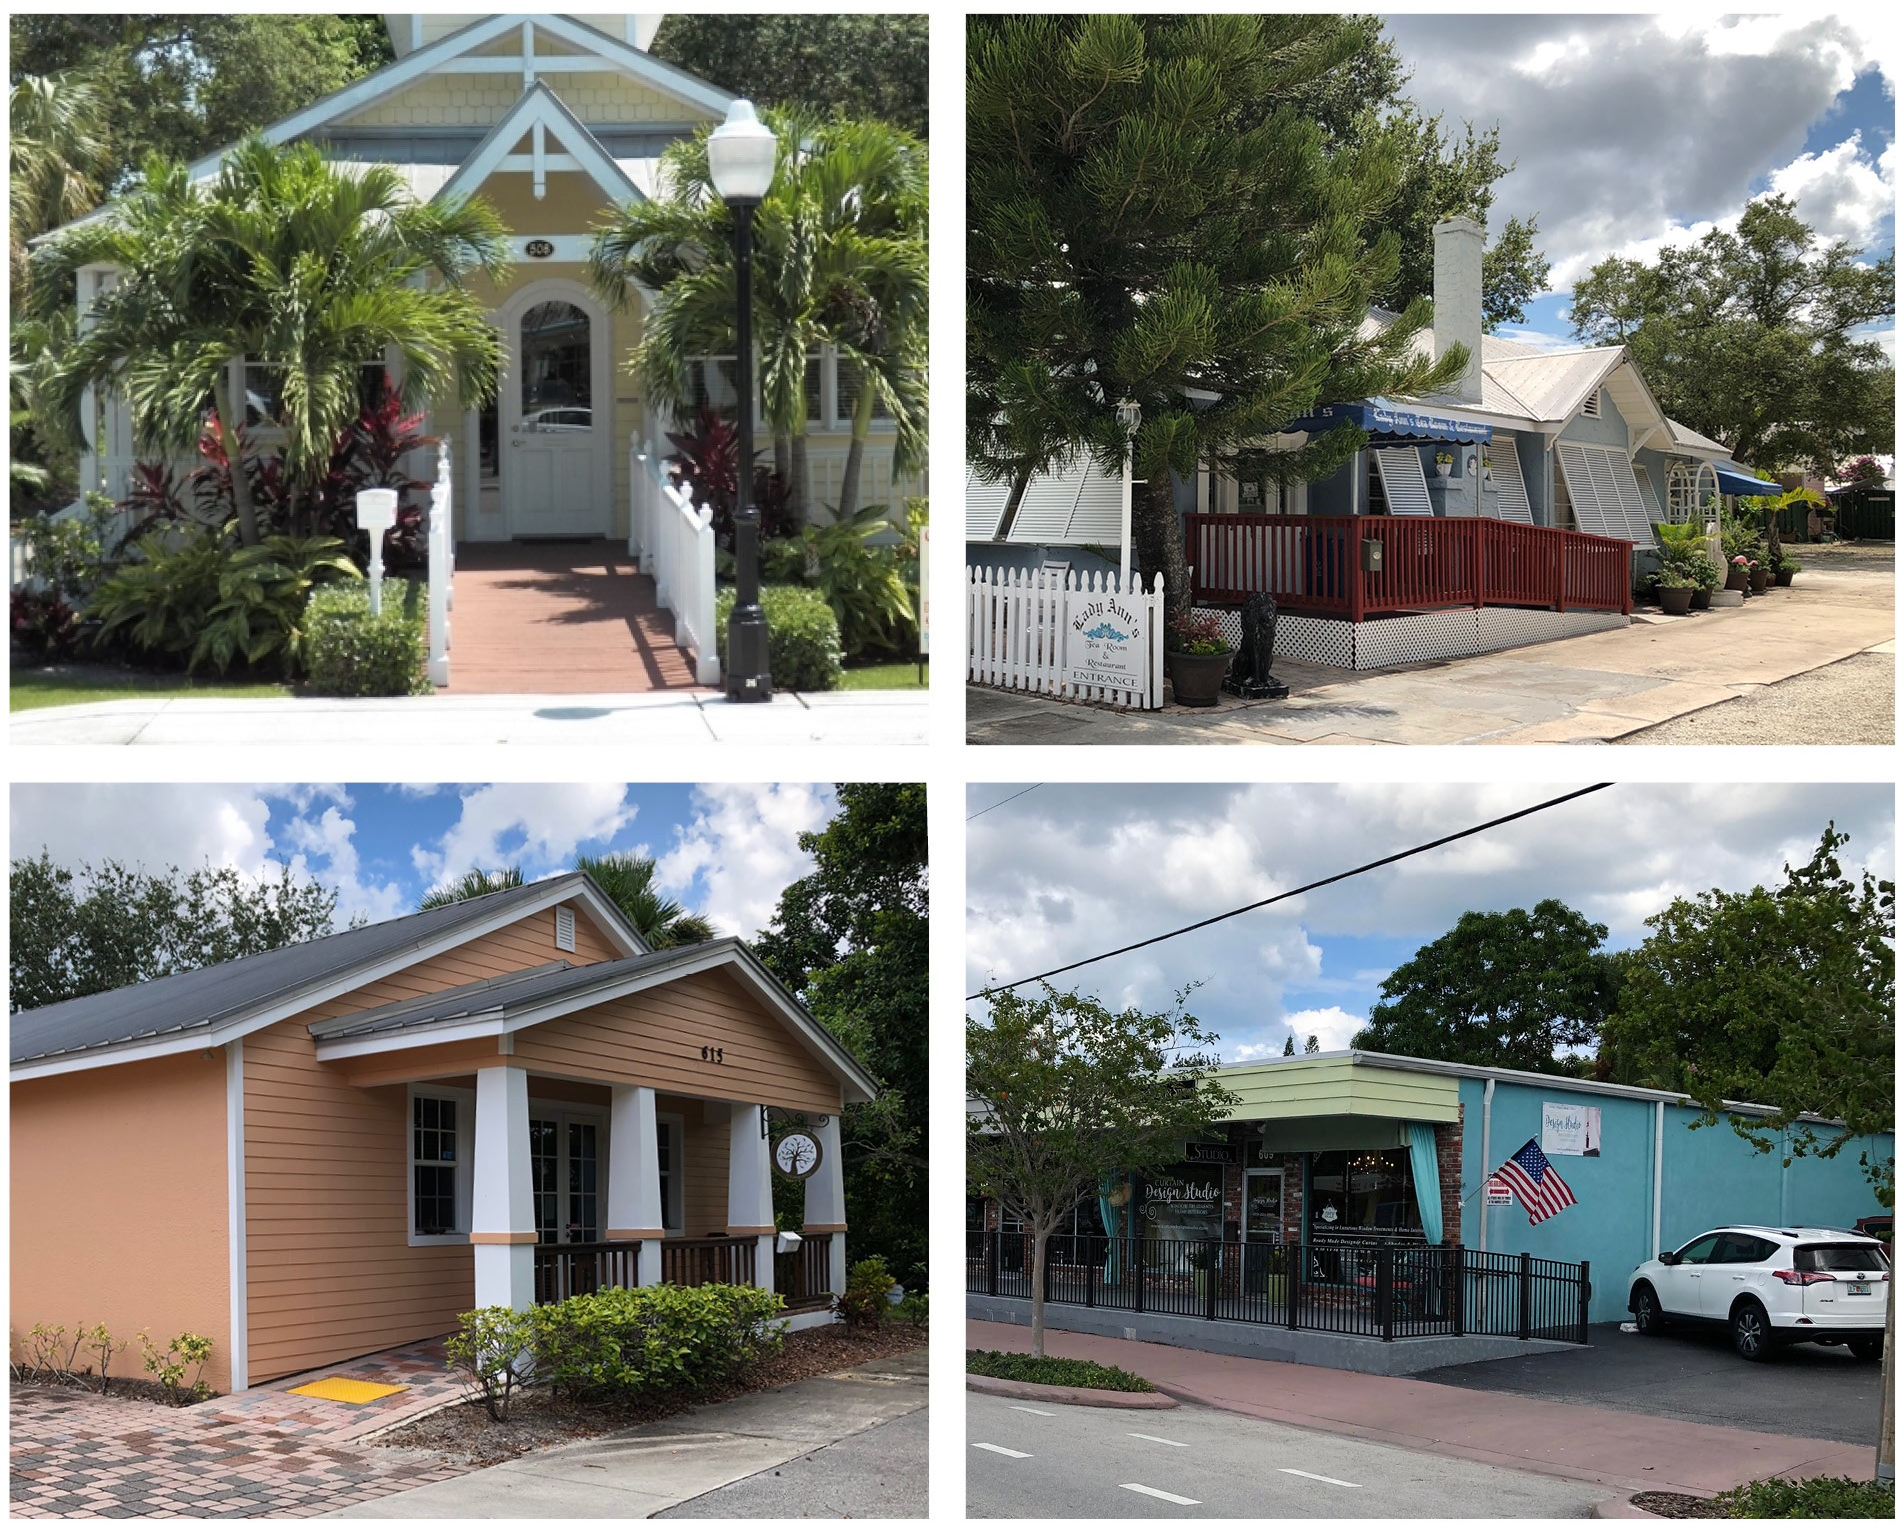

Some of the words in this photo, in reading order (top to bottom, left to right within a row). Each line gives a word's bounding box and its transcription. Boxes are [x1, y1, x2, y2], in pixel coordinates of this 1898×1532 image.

[1395, 411, 1414, 427] Ann's
[1073, 602, 1104, 631] Lady
[1107, 598, 1140, 638] Ann's
[1084, 640, 1100, 649] Tea
[1103, 642, 1128, 653] Room
[1102, 651, 1109, 660] &
[1085, 659, 1126, 670] Restaurant
[1073, 671, 1138, 687] ENTRANCE
[702, 1046, 723, 1063] 615
[1545, 1114, 1563, 1133] Design
[1563, 1115, 1582, 1131] Studio
[1154, 1179, 1184, 1188] CURTAIN
[1145, 1183, 1181, 1204] Design
[1182, 1181, 1221, 1201] Studio
